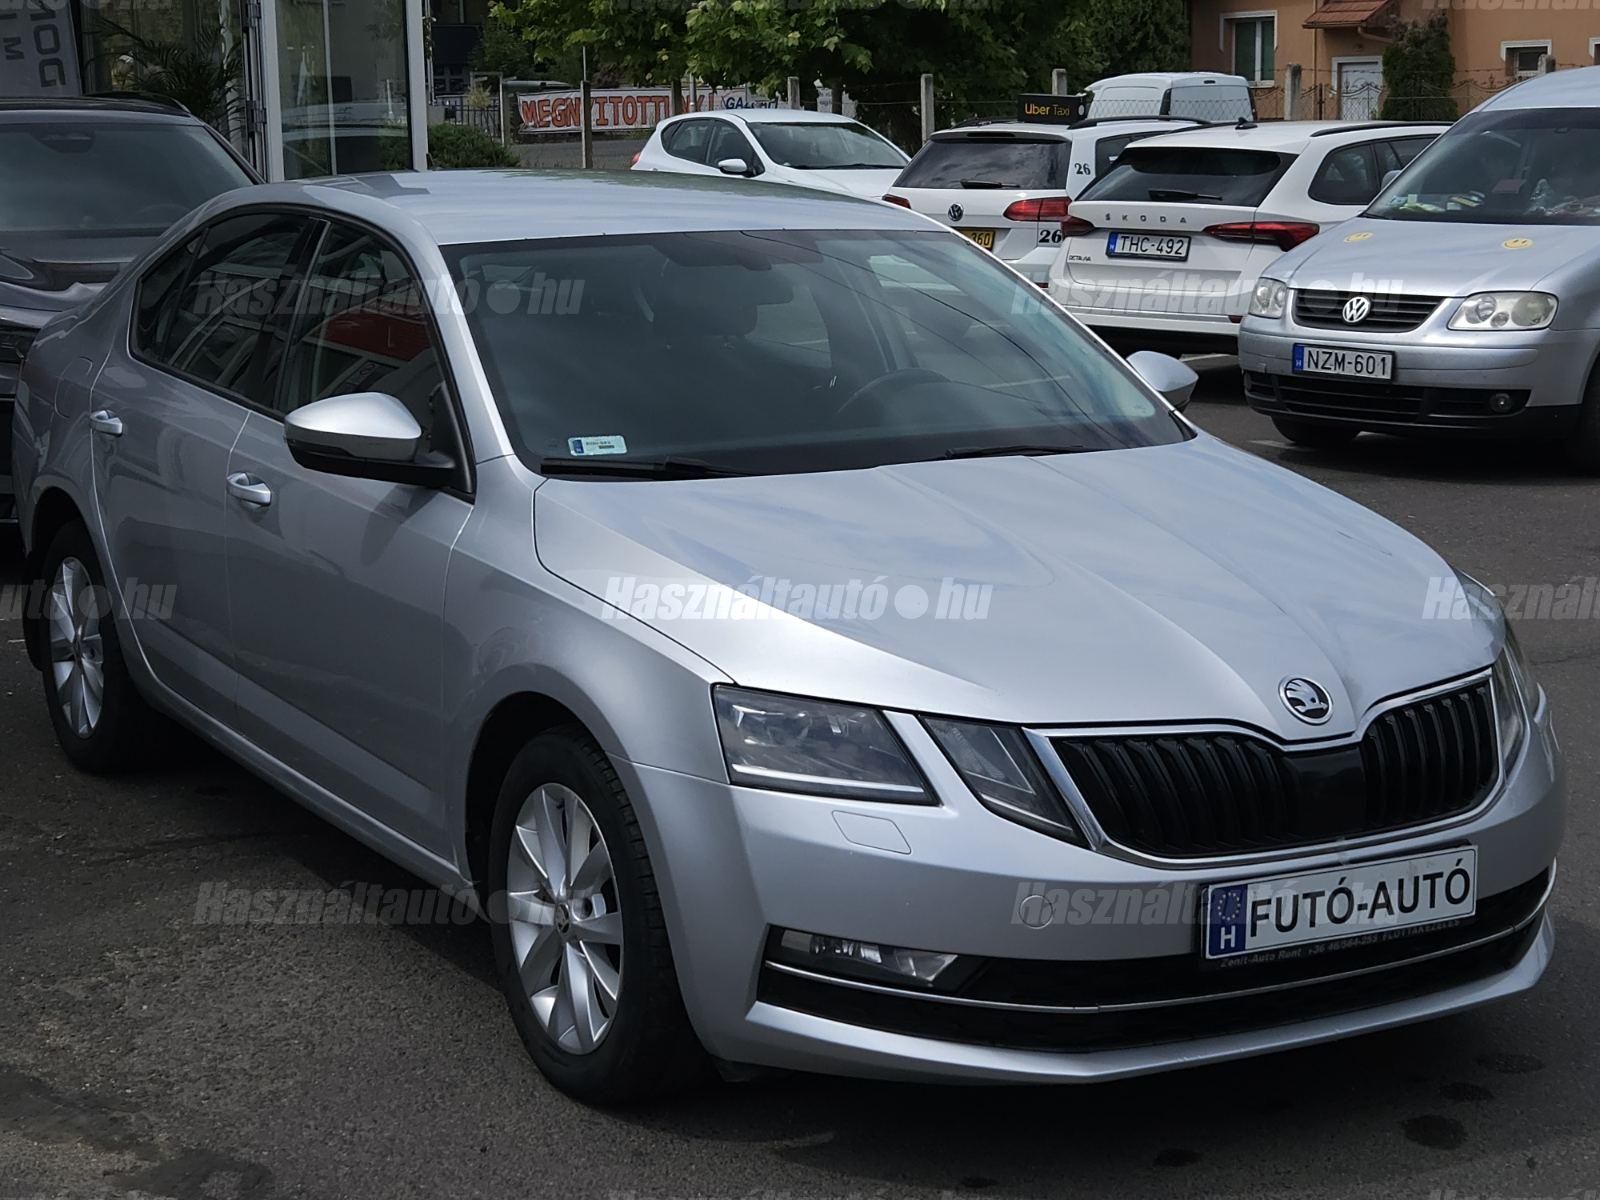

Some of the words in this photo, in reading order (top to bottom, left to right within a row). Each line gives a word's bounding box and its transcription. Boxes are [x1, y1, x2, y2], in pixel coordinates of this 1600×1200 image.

[1025, 104, 1050, 115] Uber
[1053, 104, 1070, 116] Taxi
[1074, 162, 1091, 175] 26
[1038, 229, 1063, 243] 26
[1120, 235, 1184, 255] THC-492
[1307, 350, 1386, 375] NZM-601
[1249, 858, 1472, 937] FUTÓ-AUTÓ
[1220, 925, 1236, 949] H
